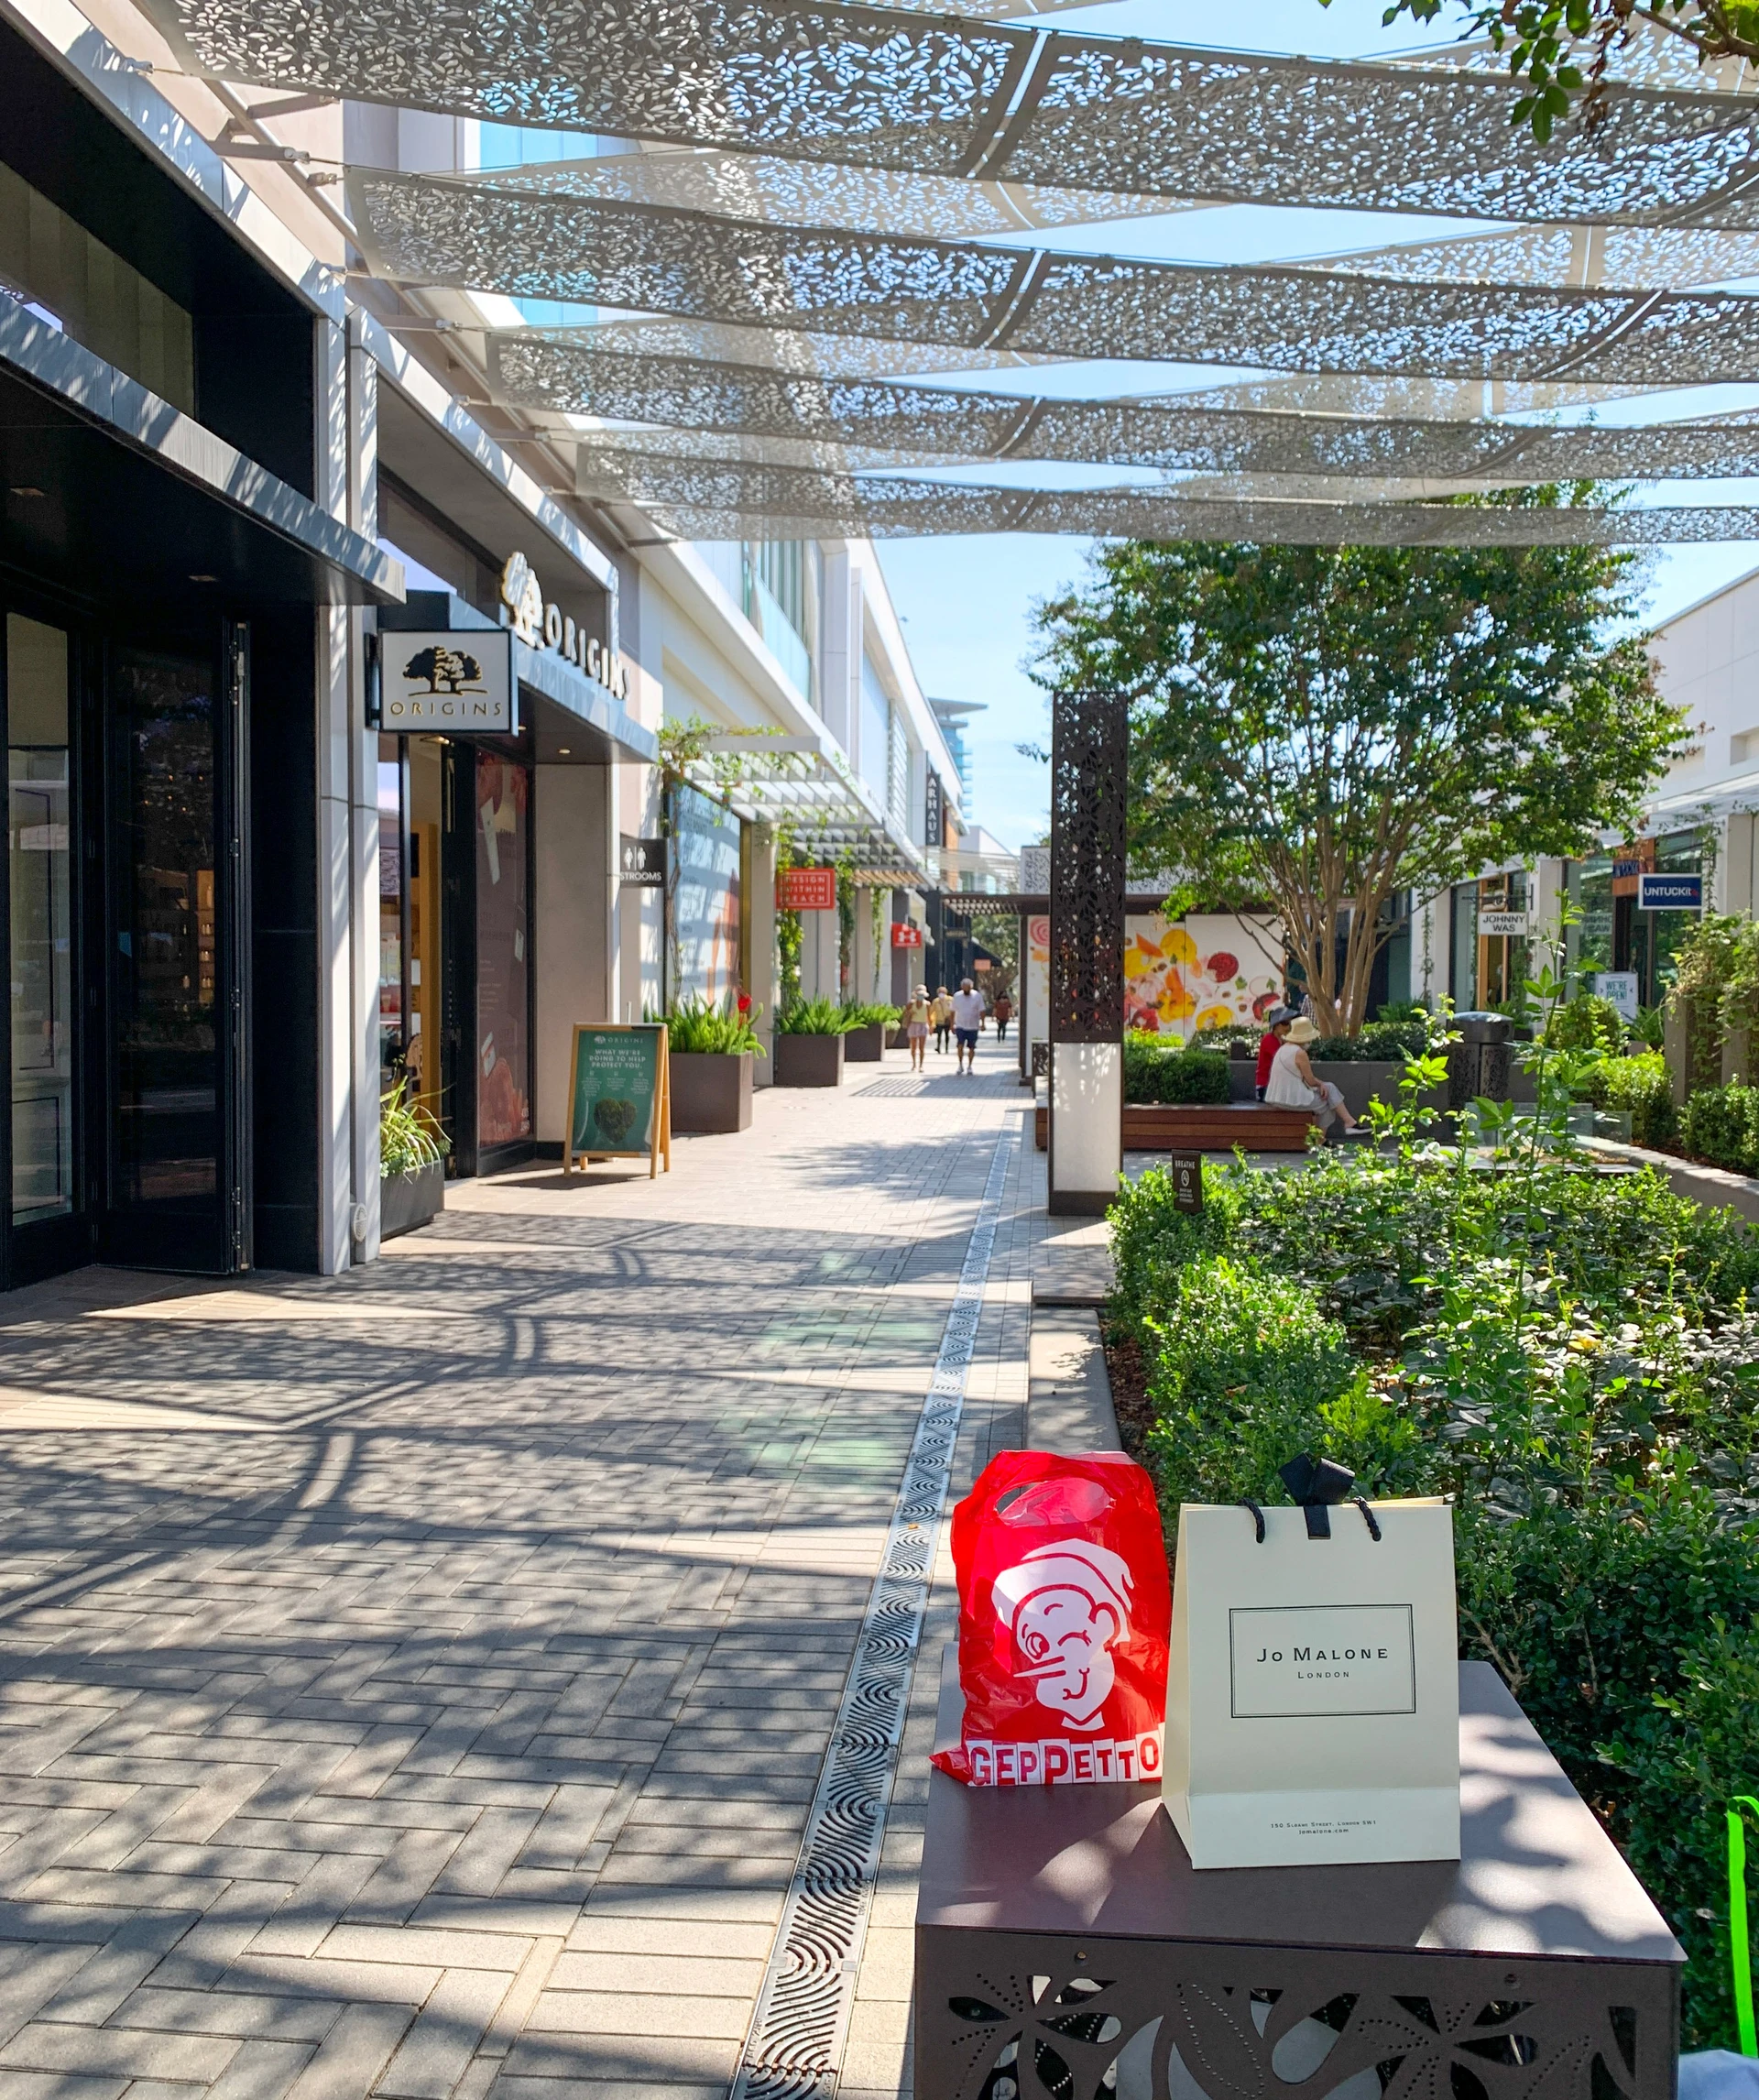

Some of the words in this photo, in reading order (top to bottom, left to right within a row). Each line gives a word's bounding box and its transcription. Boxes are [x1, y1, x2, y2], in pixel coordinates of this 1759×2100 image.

[545, 603, 631, 700] ORIGINS
[390, 702, 502, 716] ORIGINS
[927, 777, 937, 843] ARHAUS
[1482, 914, 1525, 924] JOHNNY
[1492, 924, 1515, 933] WAS
[1605, 980, 1628, 990] WE'RE
[1174, 1160, 1196, 1170] BREATHE
[970, 1736, 1160, 1786] GEPPETTO
